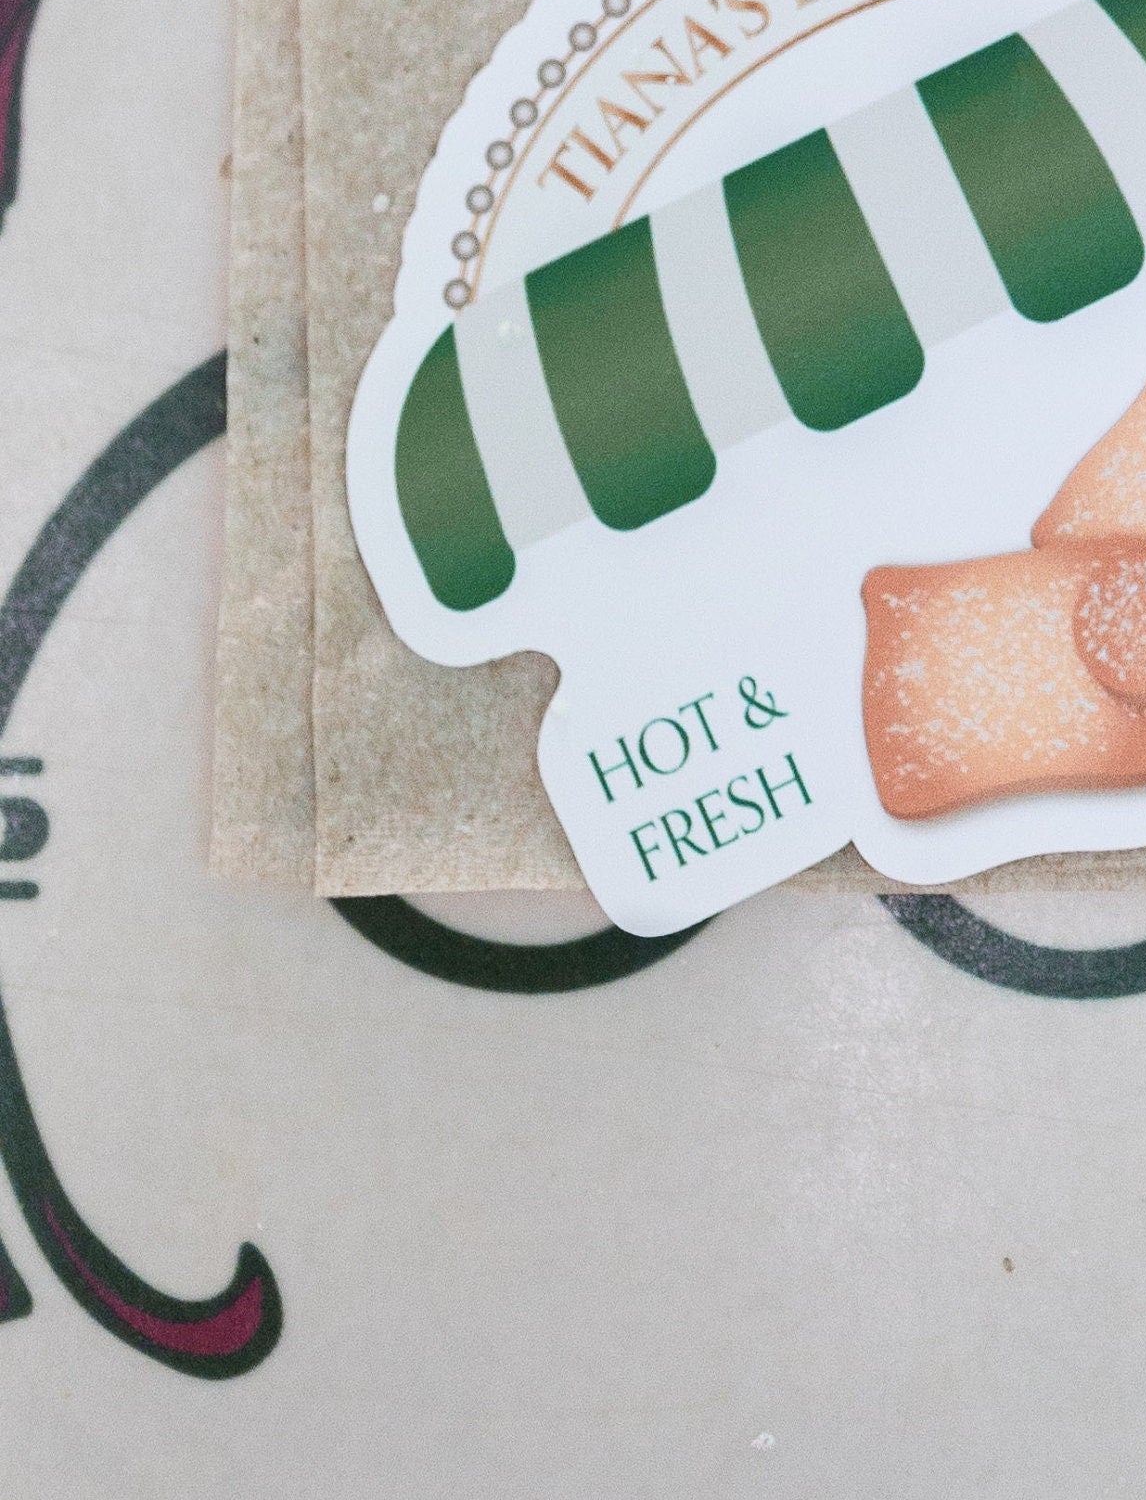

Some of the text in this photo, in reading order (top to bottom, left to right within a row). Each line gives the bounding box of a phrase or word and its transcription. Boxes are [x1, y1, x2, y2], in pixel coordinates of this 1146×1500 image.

[587, 675, 789, 803] HOT &
[628, 752, 813, 882] FRESH
